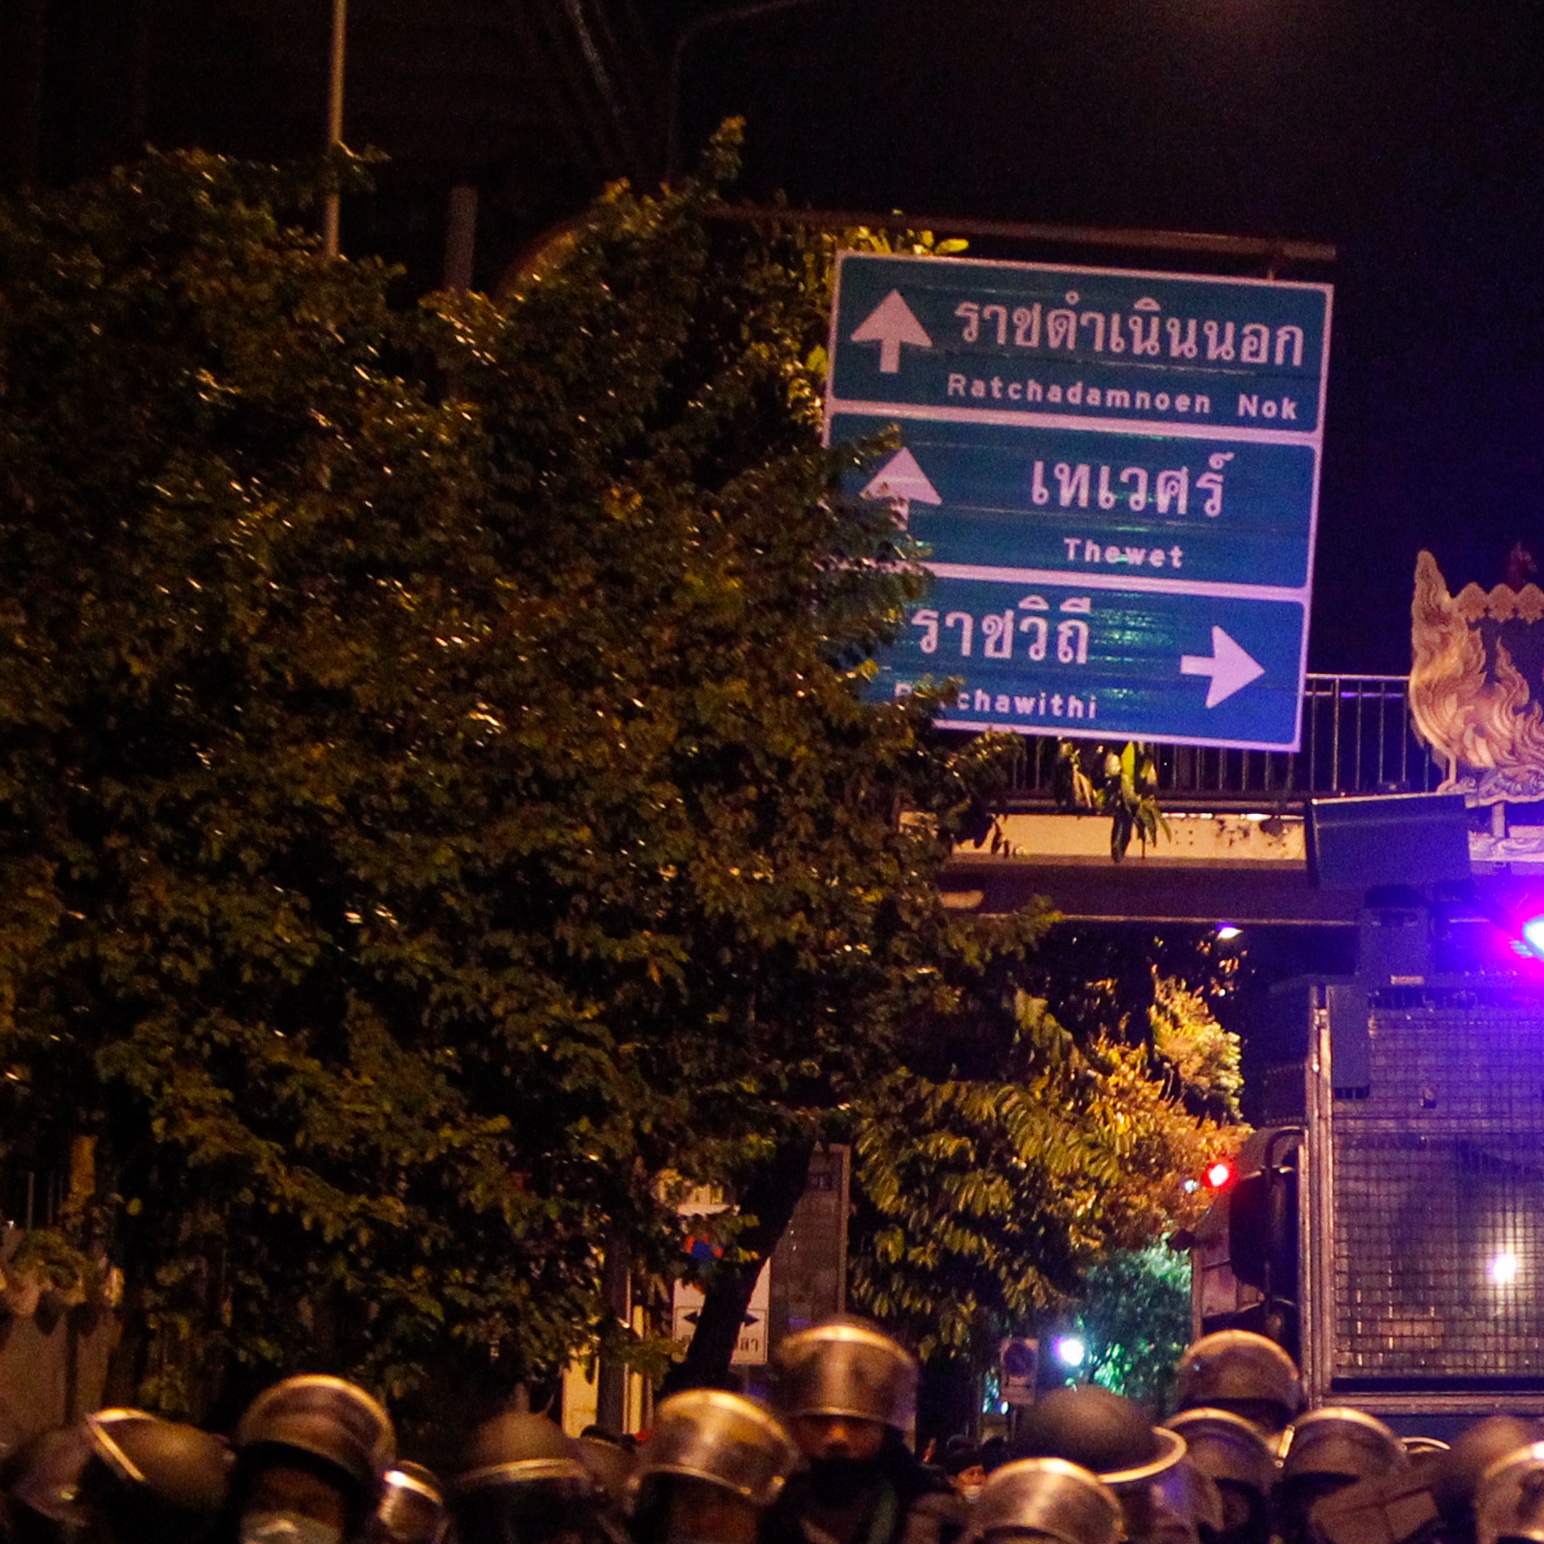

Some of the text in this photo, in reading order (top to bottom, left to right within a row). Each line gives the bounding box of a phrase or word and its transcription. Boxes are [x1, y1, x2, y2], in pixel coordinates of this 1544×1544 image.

[954, 291, 1304, 367] ราชดำเนินนอก
[946, 373, 1298, 421] Ratchadamnoen Nok
[1032, 452, 1234, 518] เทเวศร์
[1064, 538, 1183, 569] Thewet
[911, 595, 1092, 665] ราชวิถี
